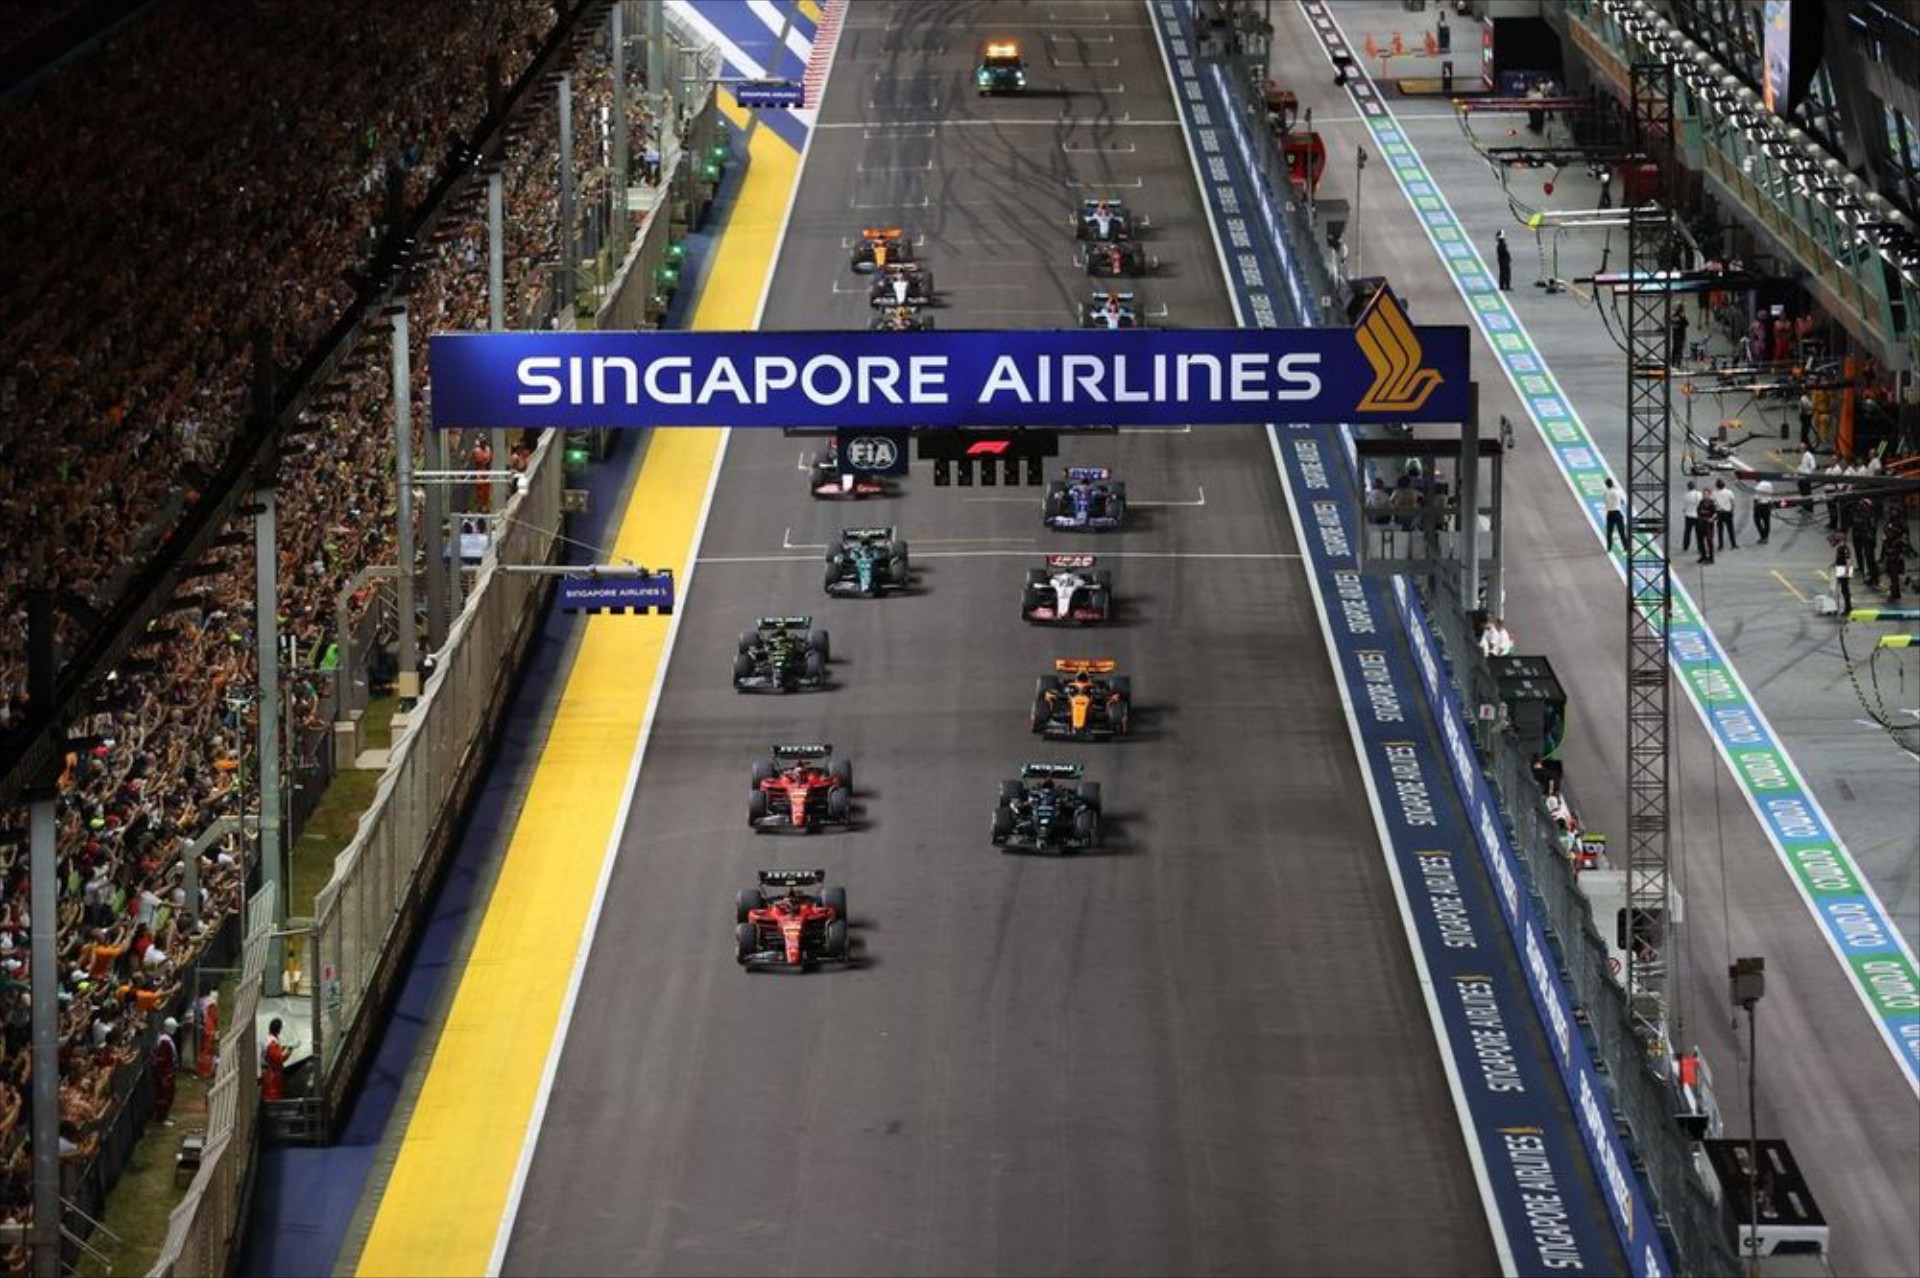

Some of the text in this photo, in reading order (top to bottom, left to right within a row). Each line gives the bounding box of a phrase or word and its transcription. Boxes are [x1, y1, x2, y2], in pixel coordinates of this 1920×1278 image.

[517, 353, 1321, 405] SINGAPORE AIRLINES
[851, 442, 893, 461] FIA
[1457, 982, 1504, 1030] AIRLINES
[1471, 1030, 1525, 1092] SINGAPORE
[1504, 1135, 1583, 1269] SINGAPORE AIRLINES
